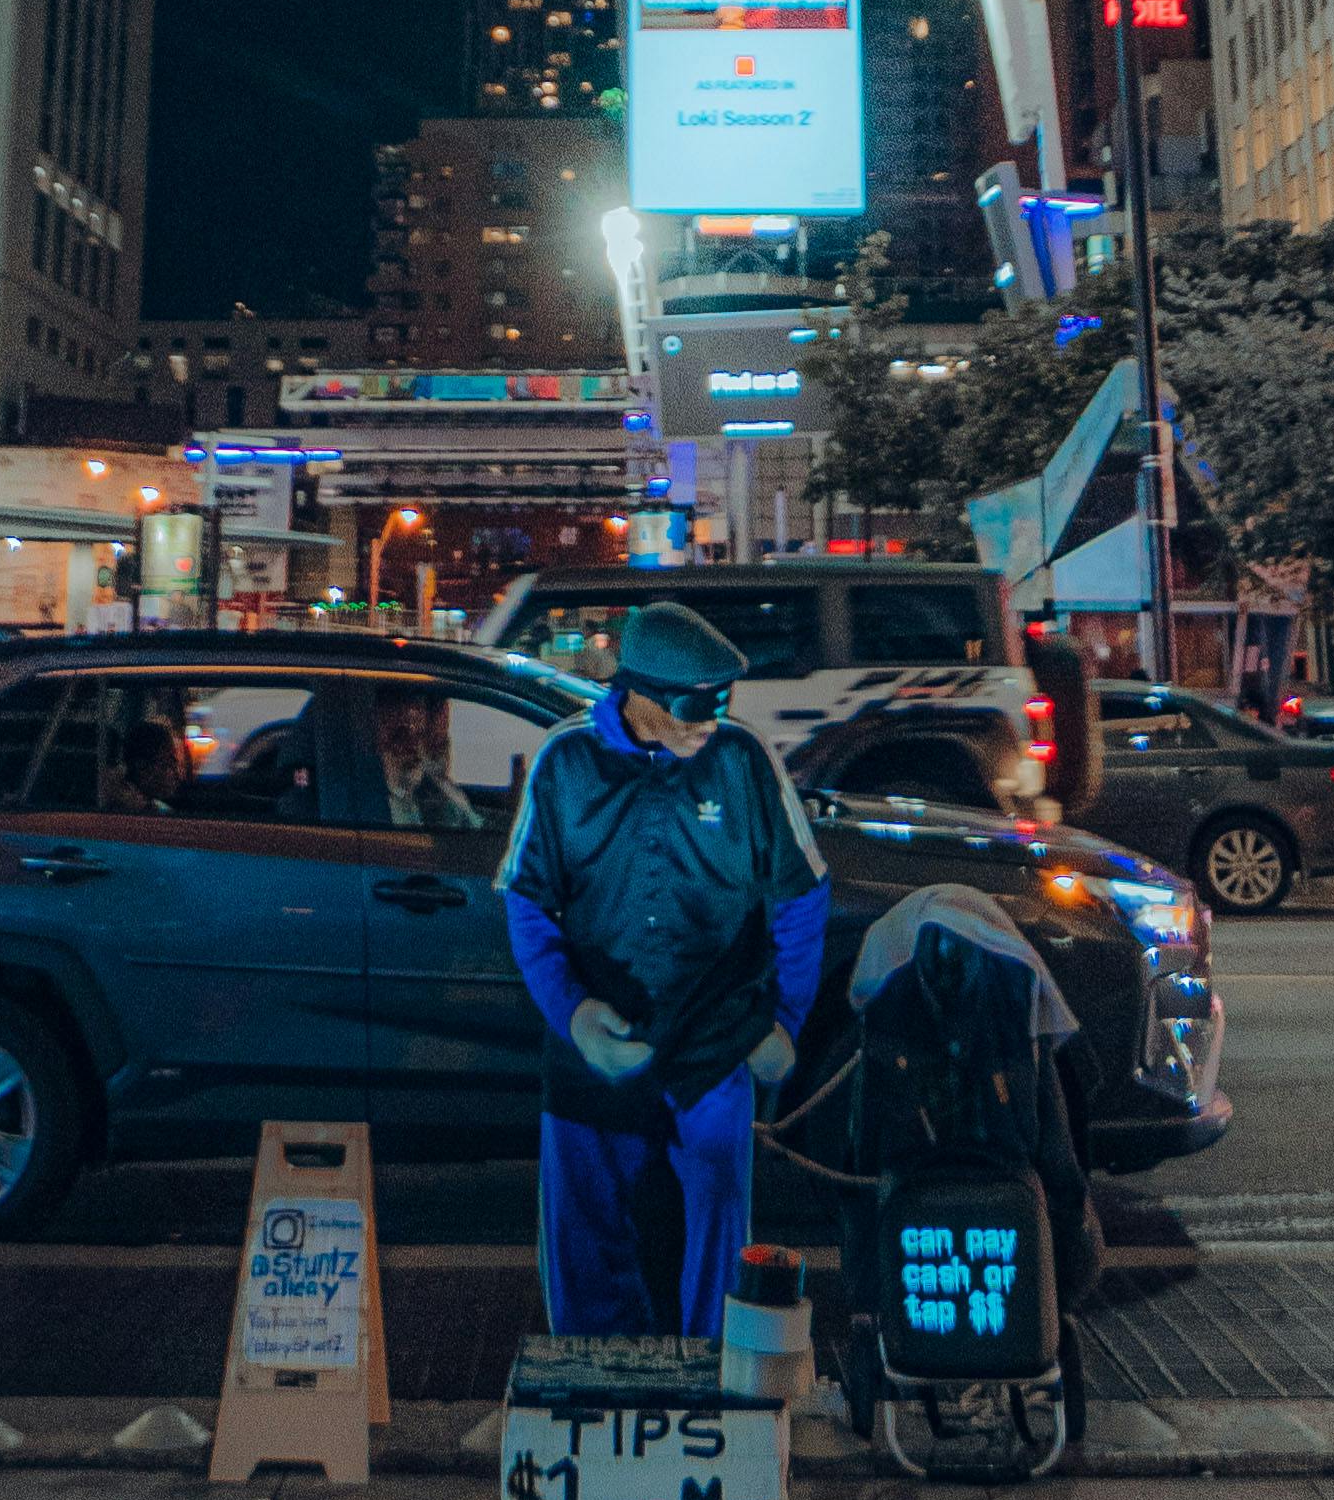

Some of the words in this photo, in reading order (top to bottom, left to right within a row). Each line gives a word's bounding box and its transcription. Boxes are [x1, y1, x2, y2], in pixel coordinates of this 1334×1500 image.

[678, 110, 718, 127] Loki
[723, 110, 794, 127] Season
[901, 1226, 954, 1257] can
[965, 1226, 1017, 1262] pay
[902, 1256, 970, 1294] cash
[983, 1263, 1017, 1295] or
[903, 1292, 957, 1335] tap
[968, 1289, 1006, 1336] $$
[550, 1406, 726, 1459] TIPS
